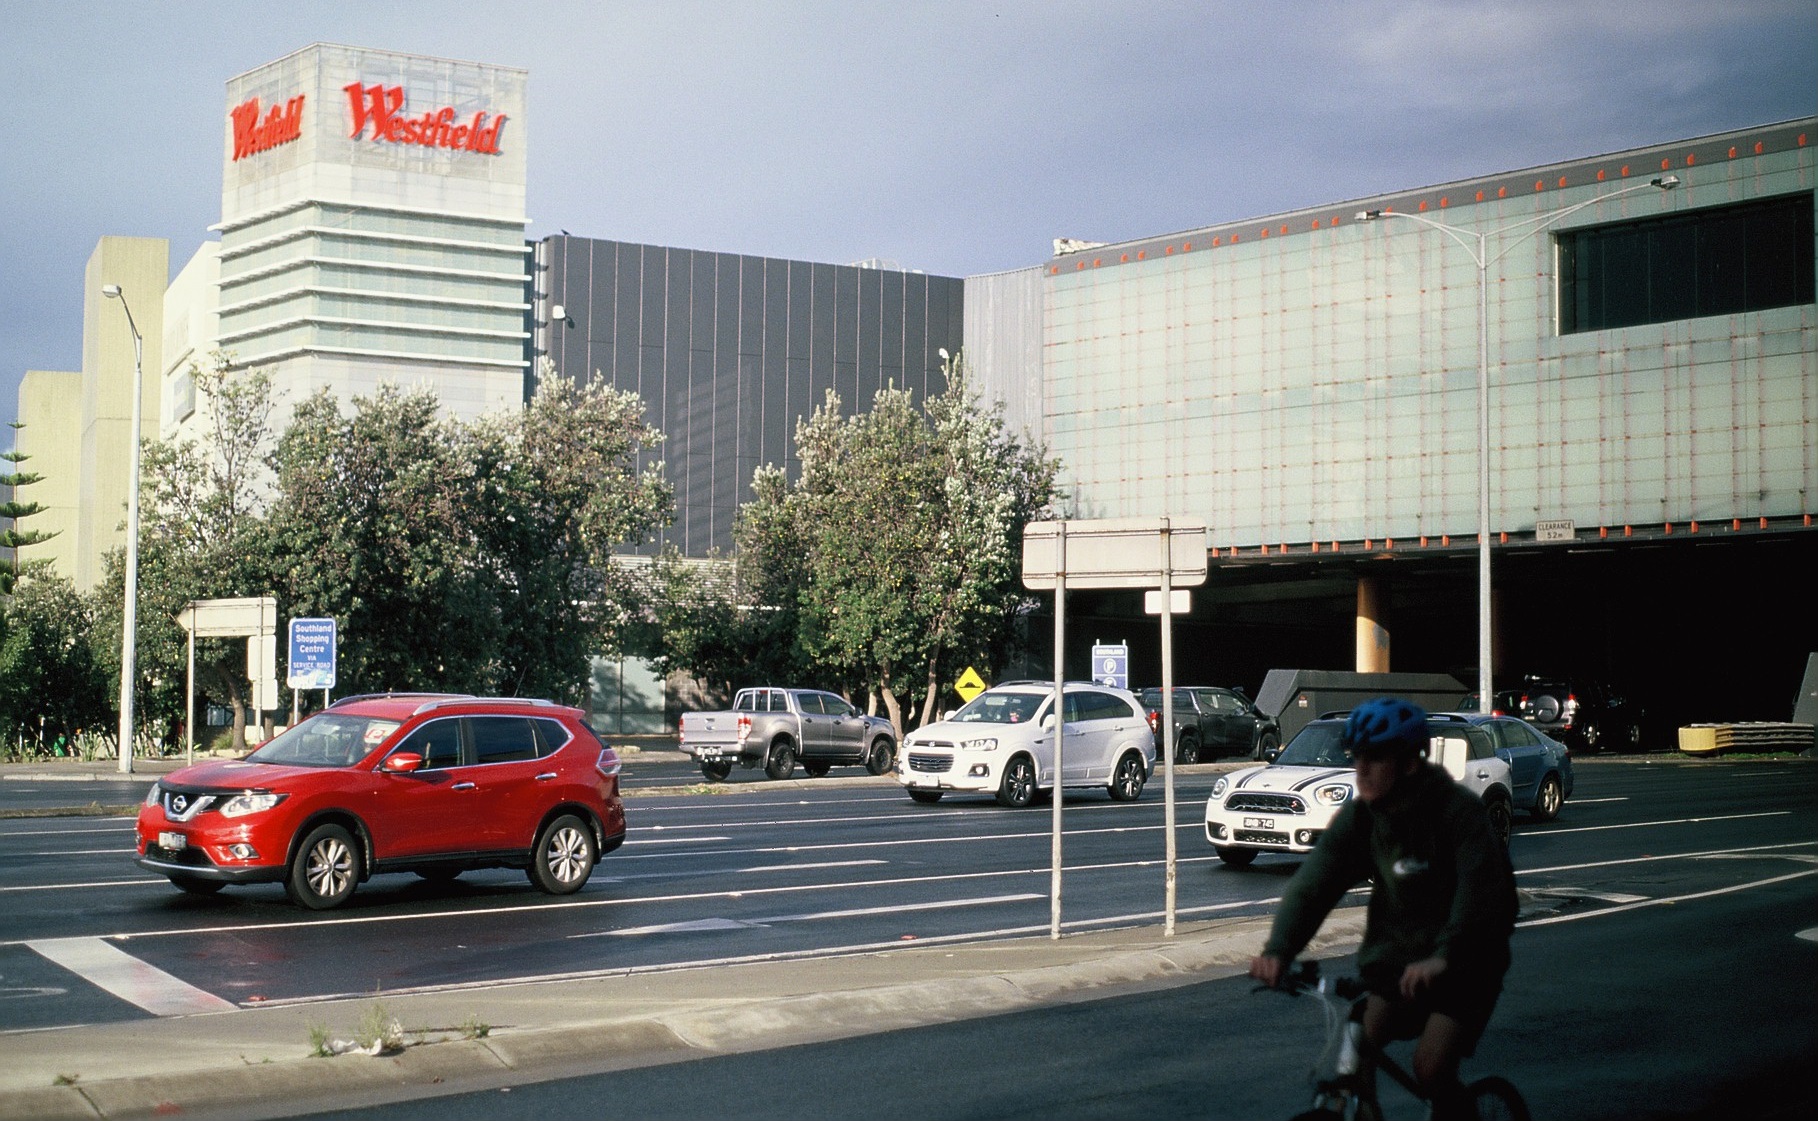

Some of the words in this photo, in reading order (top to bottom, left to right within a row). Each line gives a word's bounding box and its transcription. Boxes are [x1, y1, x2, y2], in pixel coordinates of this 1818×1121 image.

[342, 81, 507, 154] Westfield
[1538, 522, 1571, 531] CLEARANCE
[295, 624, 332, 632] Southland
[296, 634, 329, 645] Shopping
[300, 645, 325, 653] Centre
